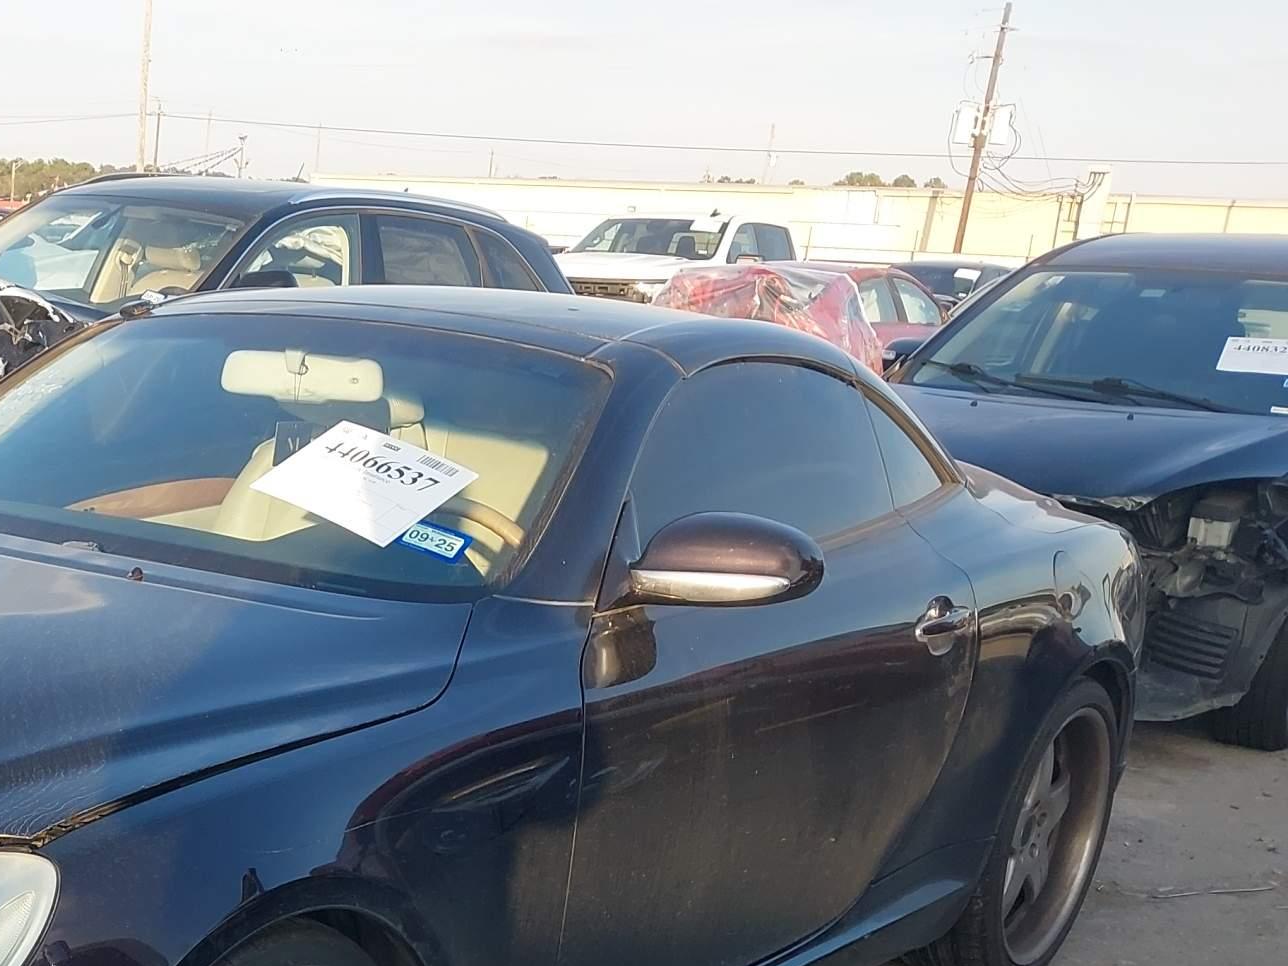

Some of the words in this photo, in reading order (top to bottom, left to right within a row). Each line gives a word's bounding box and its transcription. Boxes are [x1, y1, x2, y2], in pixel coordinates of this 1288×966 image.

[324, 442, 441, 492] 44066537
[408, 529, 430, 542] 09
[434, 538, 457, 552] 25
